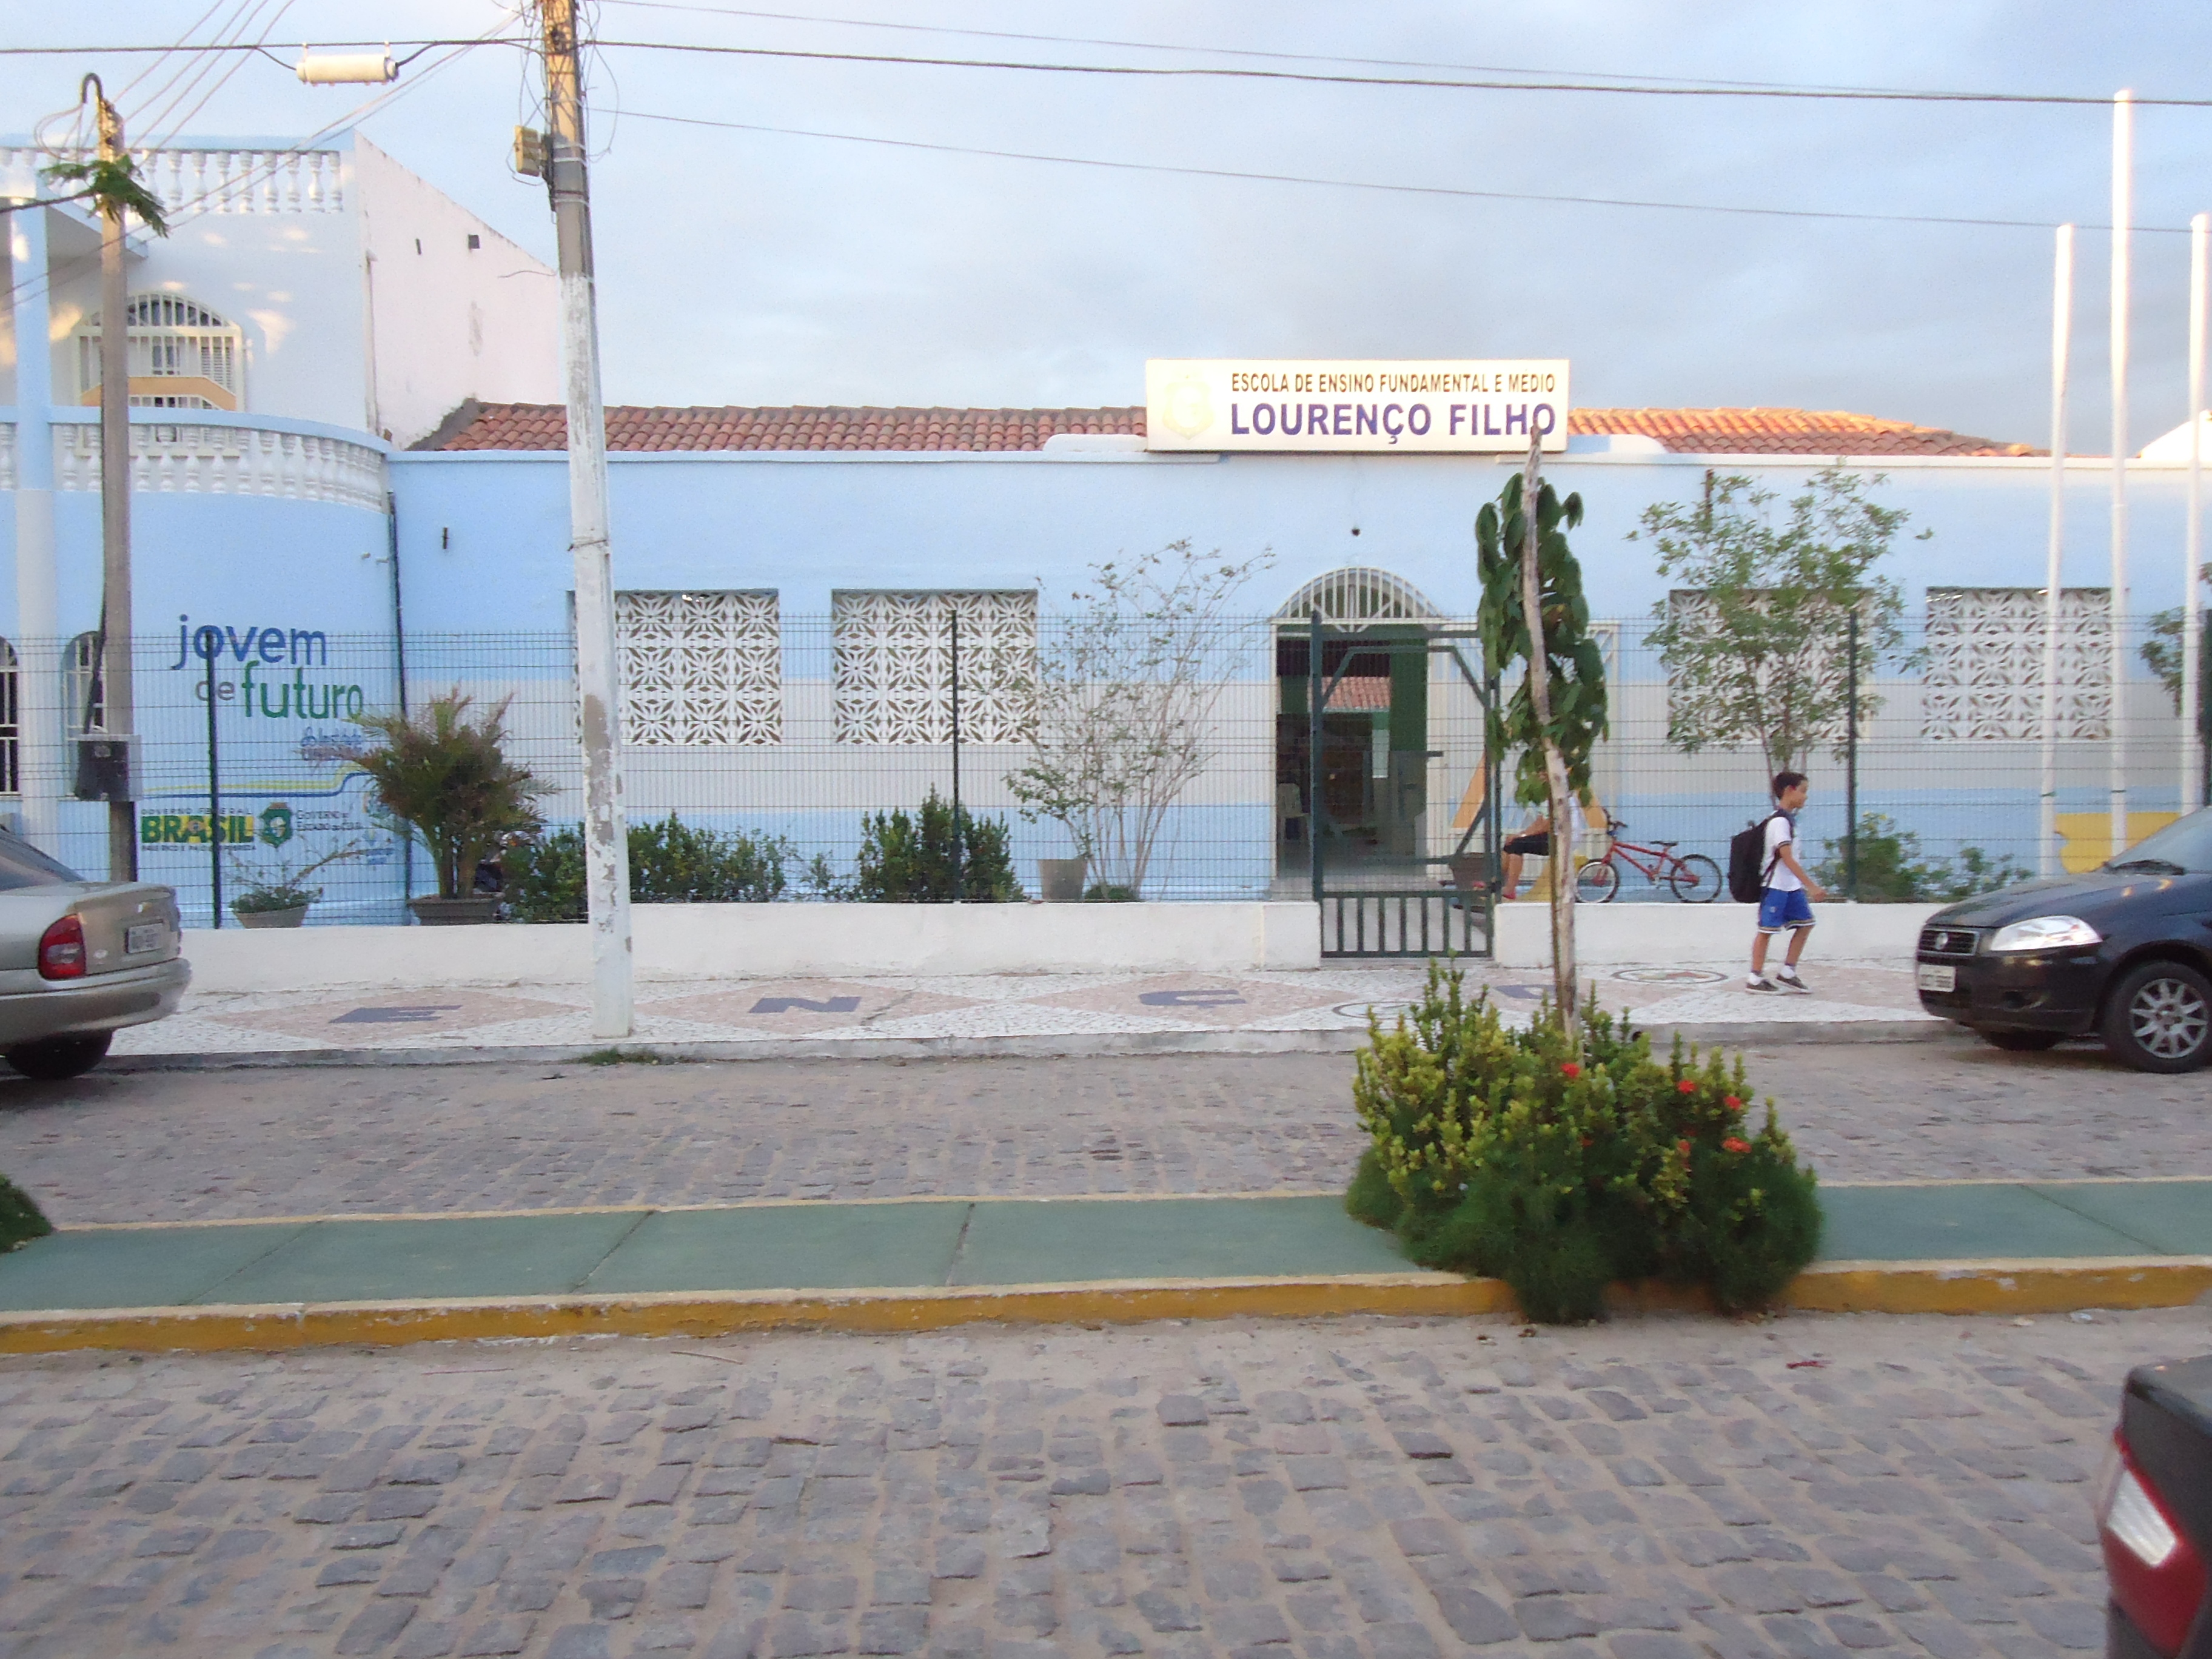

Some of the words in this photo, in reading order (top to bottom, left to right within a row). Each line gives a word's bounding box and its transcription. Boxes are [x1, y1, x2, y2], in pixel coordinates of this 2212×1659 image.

[1232, 373, 1289, 392] ESCOLA
[1295, 374, 1313, 392] DE
[1319, 374, 1374, 392] ENSINO
[1380, 374, 1489, 392] FUNDAMENTAL
[1495, 374, 1502, 392] E
[1232, 403, 1432, 444] LOURENÇO
[1449, 403, 1556, 435] FILHO
[170, 614, 326, 671] jovem
[241, 660, 364, 719] futuro
[142, 816, 255, 843] BRASIL
